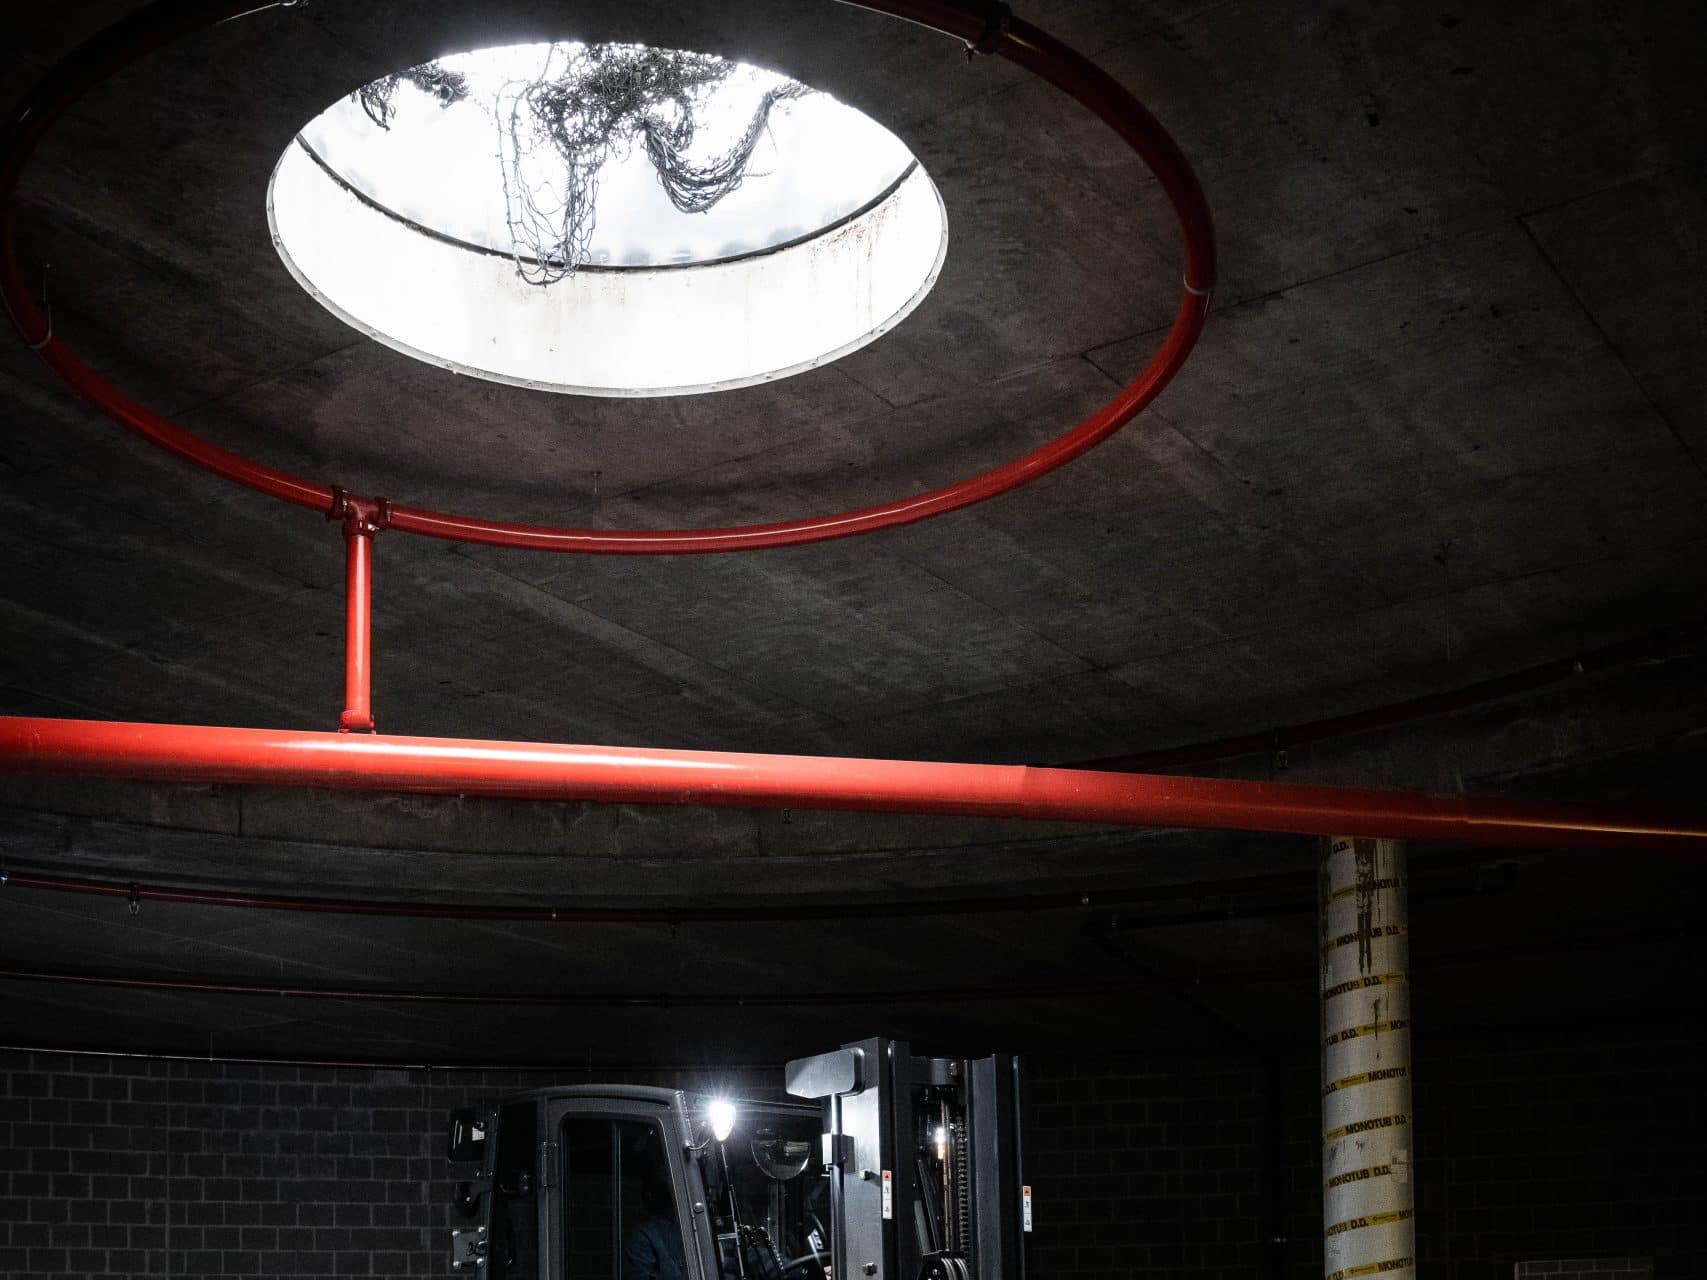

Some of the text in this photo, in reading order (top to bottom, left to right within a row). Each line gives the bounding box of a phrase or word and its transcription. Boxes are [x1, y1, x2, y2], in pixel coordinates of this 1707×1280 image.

[1345, 1117, 1392, 1134] MONOTUB
[1328, 1166, 1391, 1188] MONOTUB D.D.
[1351, 1218, 1369, 1229] D.D.
